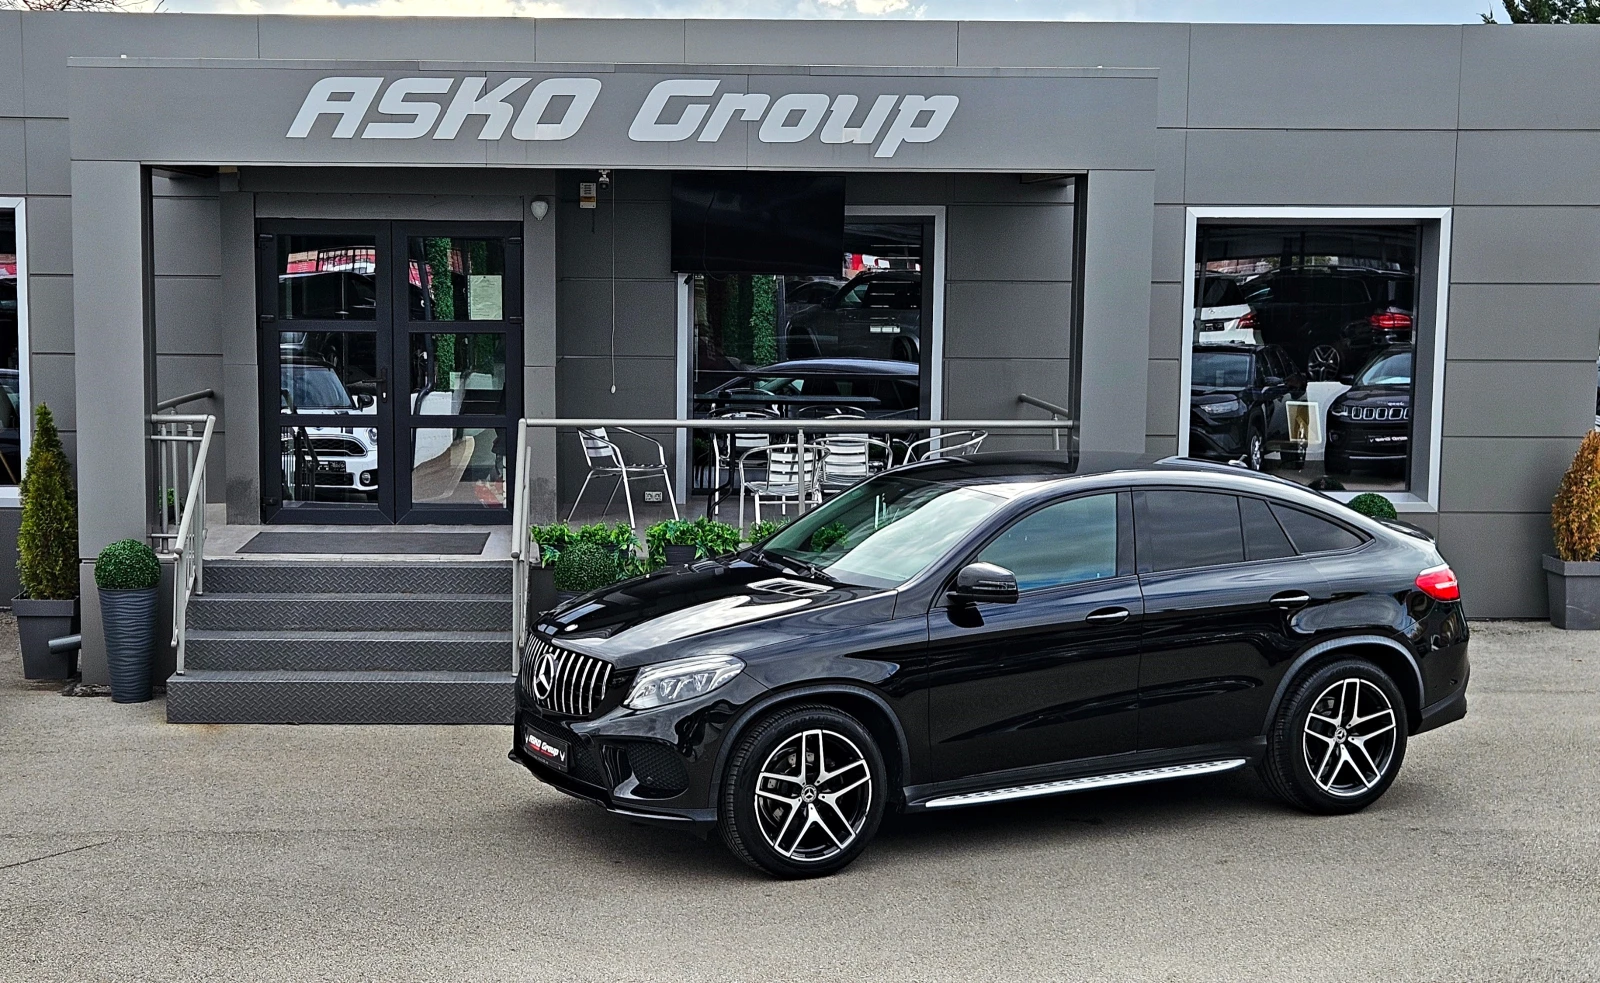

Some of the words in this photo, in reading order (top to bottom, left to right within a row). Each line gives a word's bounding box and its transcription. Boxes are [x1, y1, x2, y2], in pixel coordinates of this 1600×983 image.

[286, 76, 602, 141] ASKO
[628, 79, 960, 158] Group
[541, 742, 559, 757] Group
